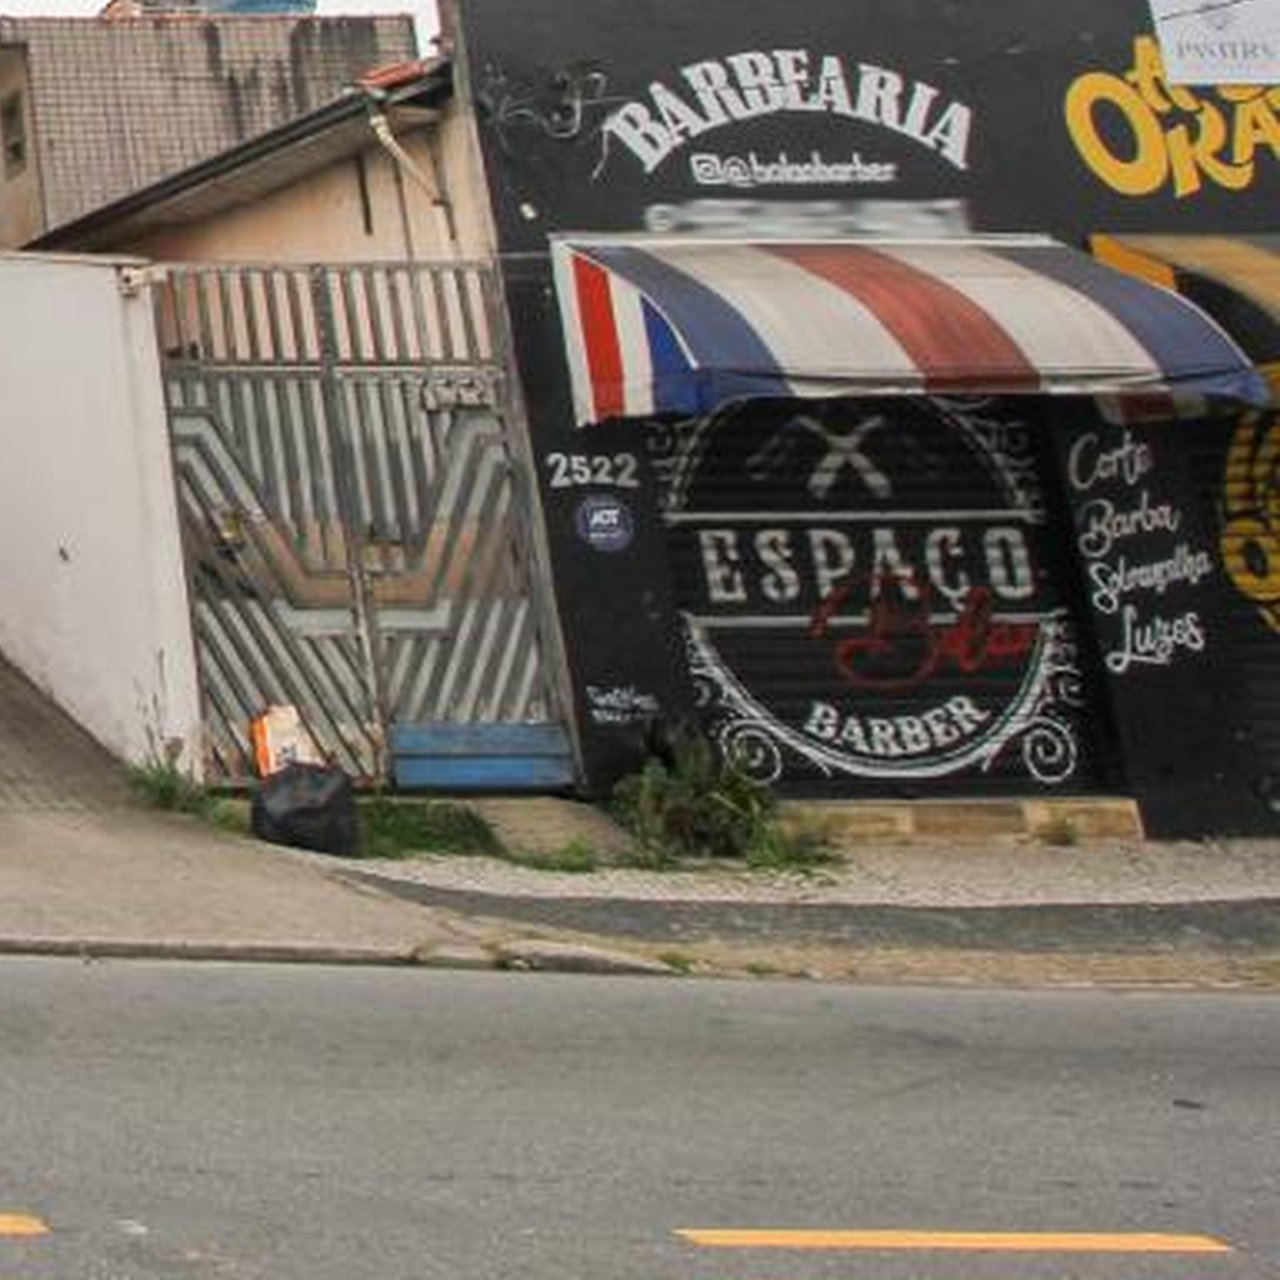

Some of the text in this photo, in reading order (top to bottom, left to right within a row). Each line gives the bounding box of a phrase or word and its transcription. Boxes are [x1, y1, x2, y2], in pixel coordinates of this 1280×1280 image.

[602, 48, 970, 174] BARBEARIA
[546, 451, 640, 488] 2522
[1068, 429, 1152, 490] Corte
[1077, 489, 1182, 558] Barba
[698, 527, 1035, 612] ESPAÇO
[1104, 603, 1205, 673] Luzes
[803, 695, 991, 755] BARBER
